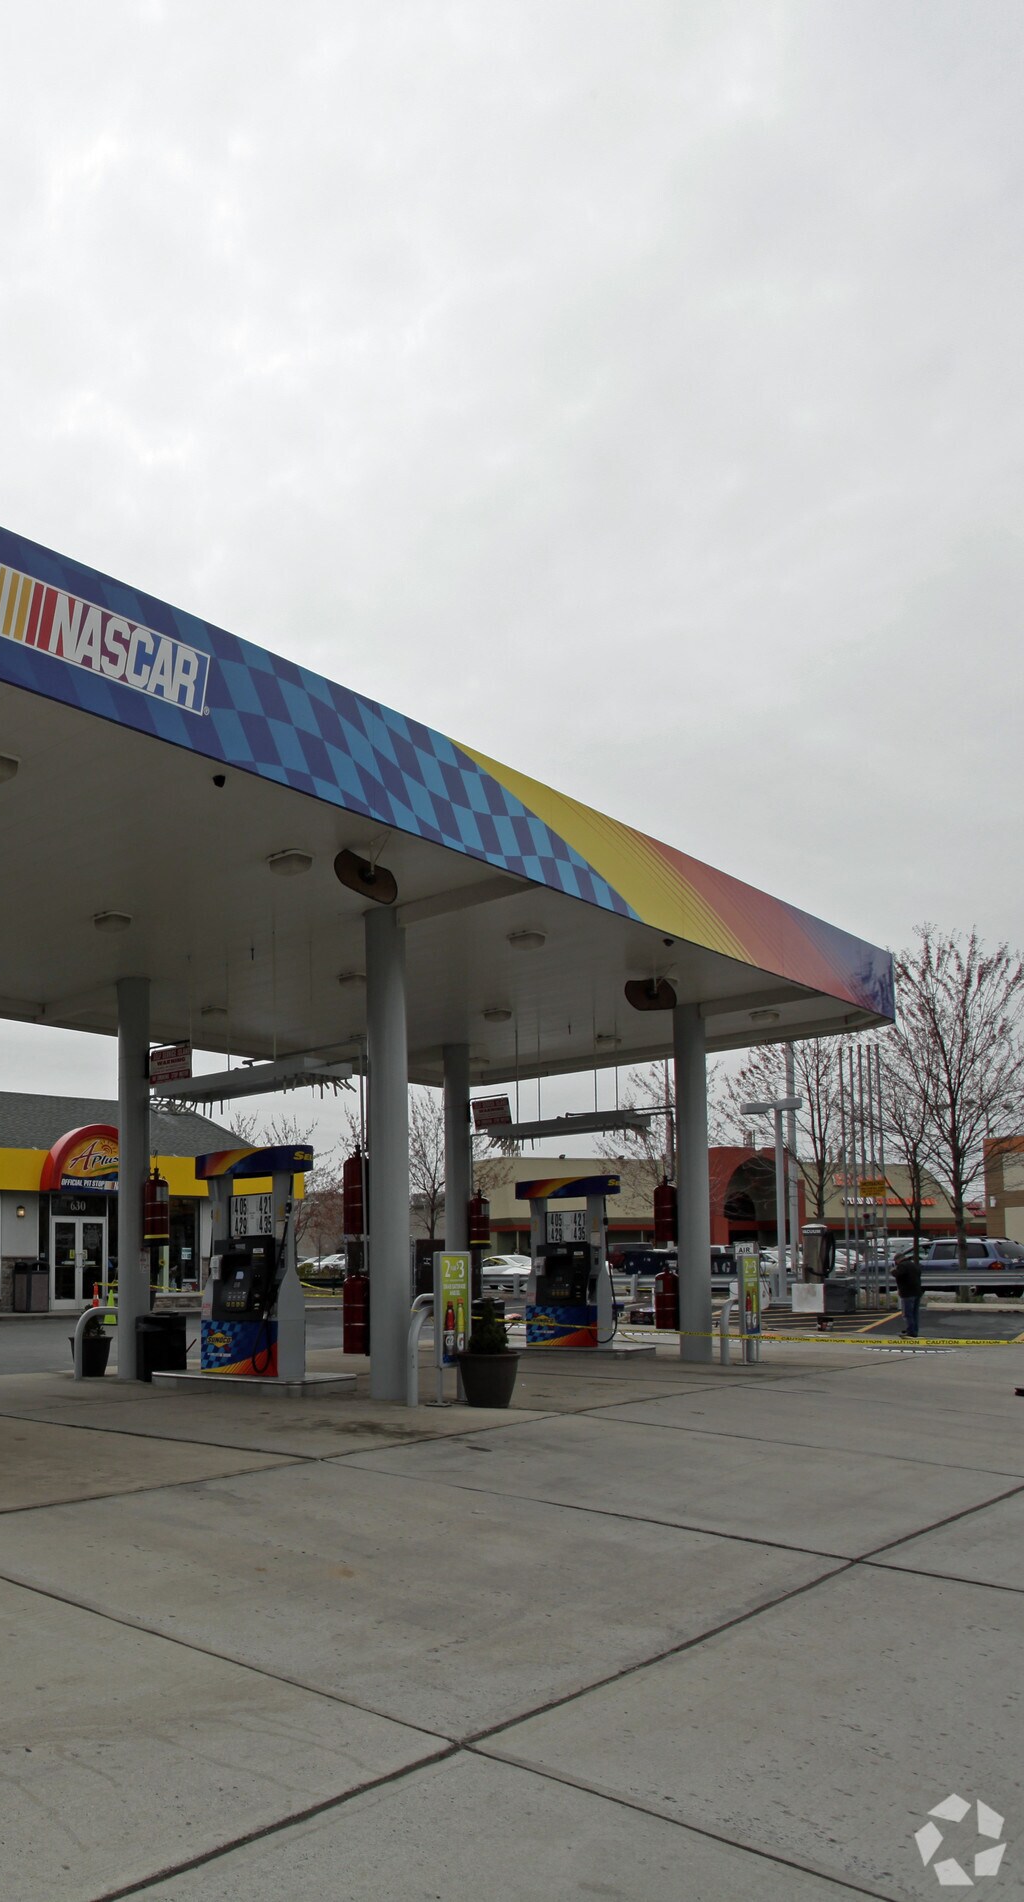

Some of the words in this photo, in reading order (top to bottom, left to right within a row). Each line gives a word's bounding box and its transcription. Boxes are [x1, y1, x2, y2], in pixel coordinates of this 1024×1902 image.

[47, 592, 199, 709] NASCAR
[157, 1057, 186, 1066] WARNING
[444, 1260, 451, 1278] 2
[206, 1336, 232, 1344] SUNOCO
